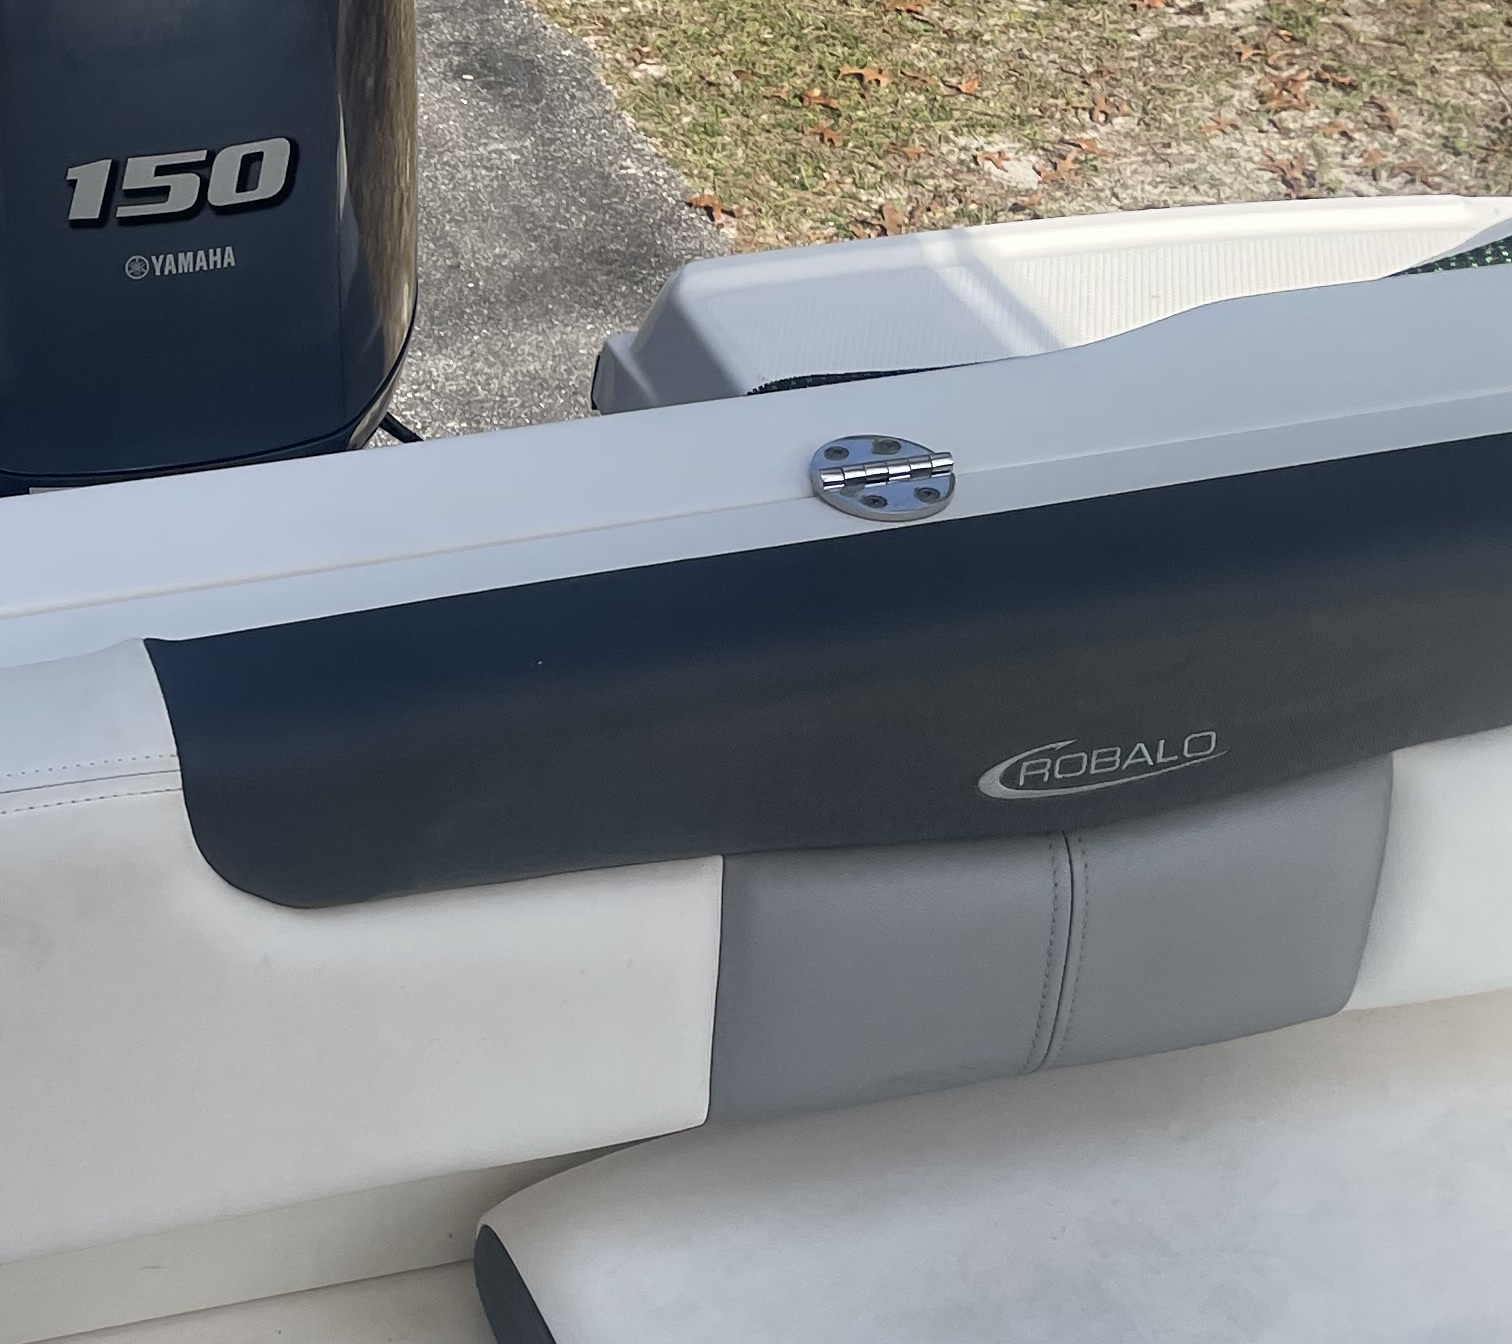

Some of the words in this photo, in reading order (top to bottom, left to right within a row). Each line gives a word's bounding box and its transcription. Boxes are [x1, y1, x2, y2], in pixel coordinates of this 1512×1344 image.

[66, 137, 293, 222] 150
[151, 245, 236, 276] YAMAHA
[1018, 730, 1217, 786] ROBALO
